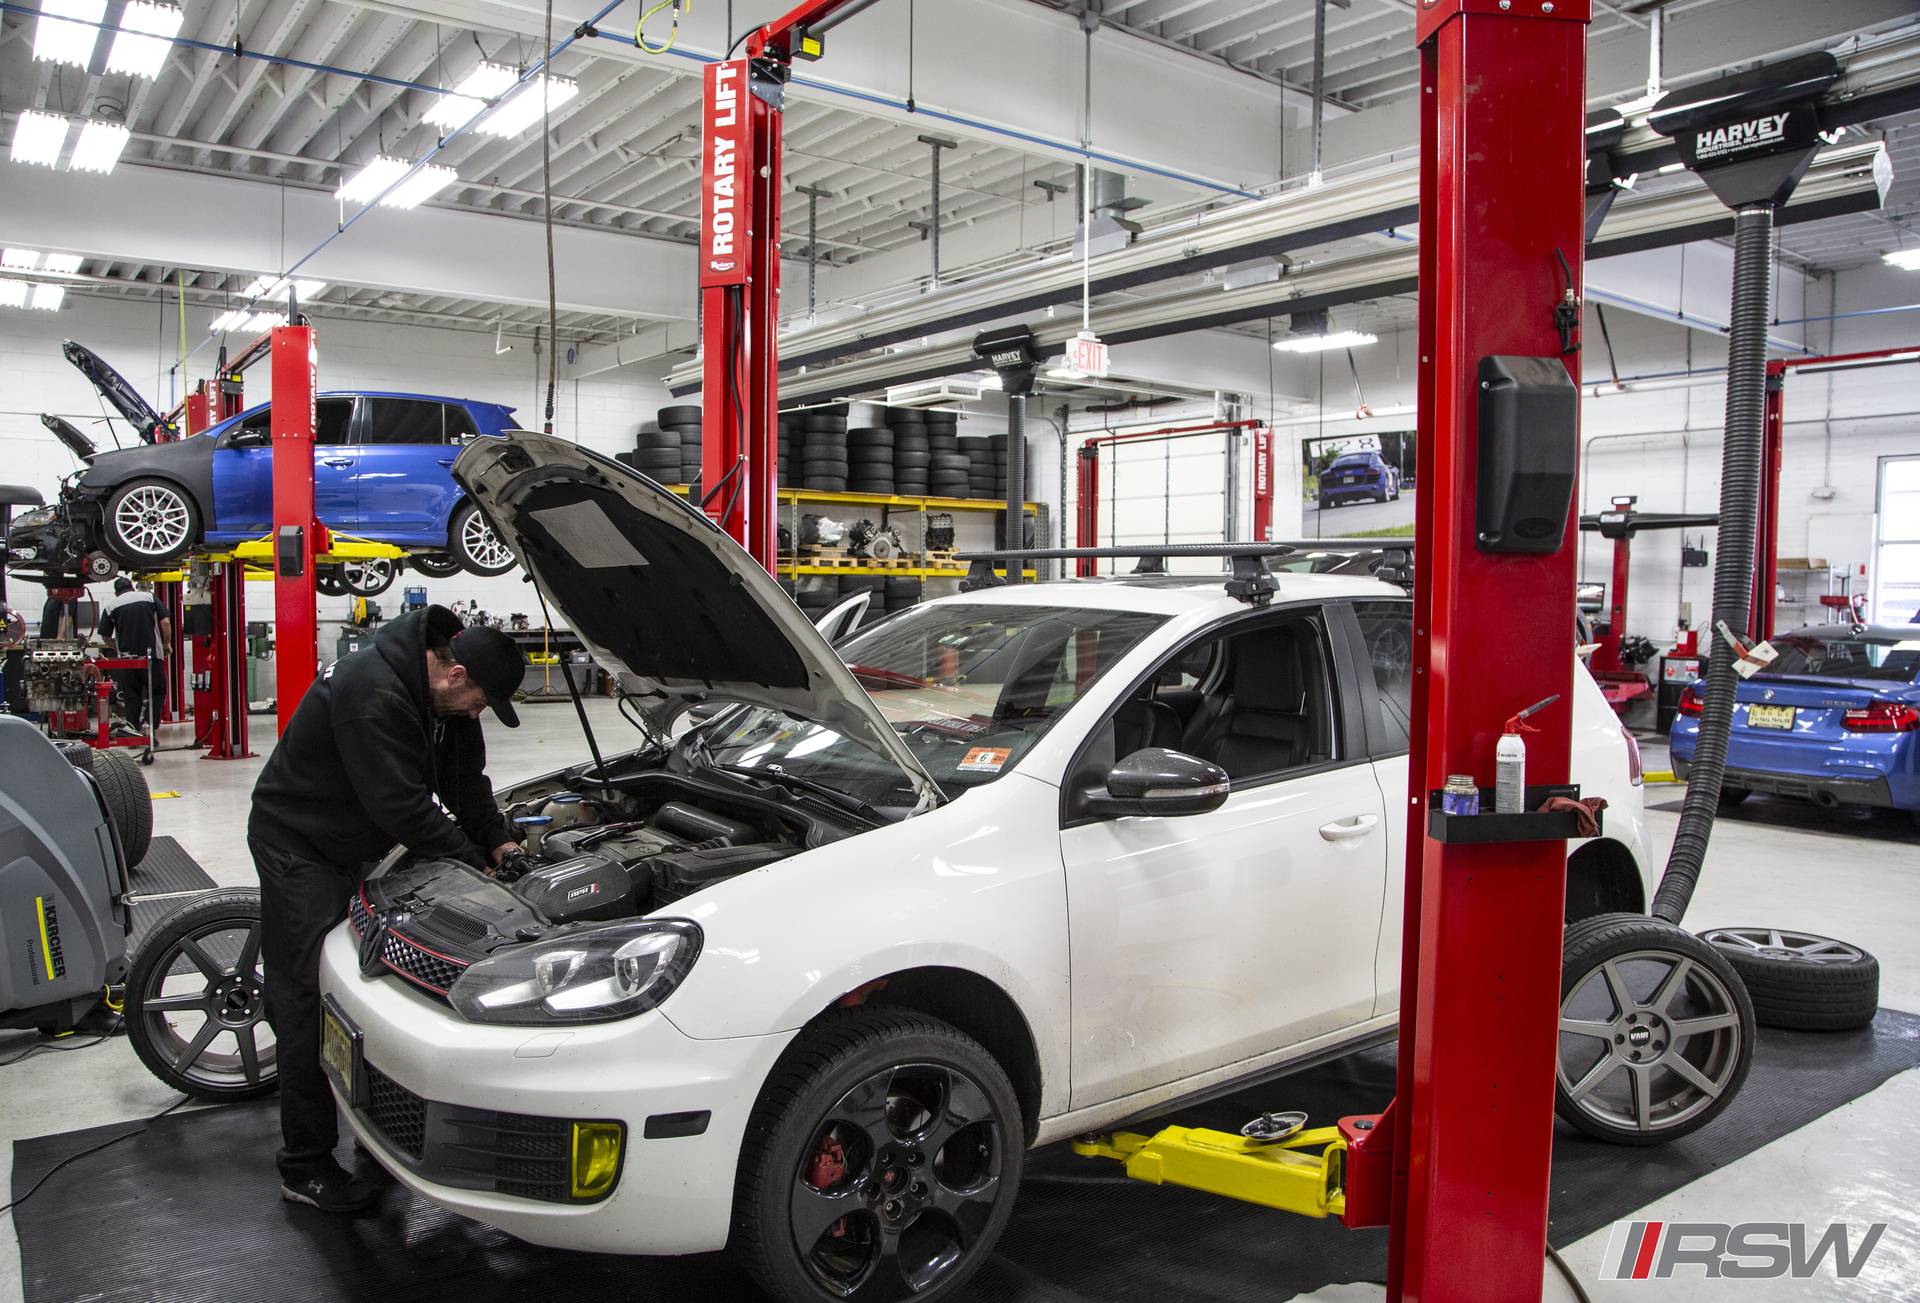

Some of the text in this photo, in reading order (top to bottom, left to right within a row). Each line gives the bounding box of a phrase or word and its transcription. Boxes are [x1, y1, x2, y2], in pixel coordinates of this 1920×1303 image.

[1697, 112, 1790, 148] HARVEY
[712, 66, 737, 255] ROTARY LIFT
[991, 349, 1021, 362] HARVEY
[1077, 342, 1103, 371] EXIT
[209, 382, 217, 406] LIFT
[1257, 452, 1267, 490] ROTARY
[979, 753, 989, 762] 6
